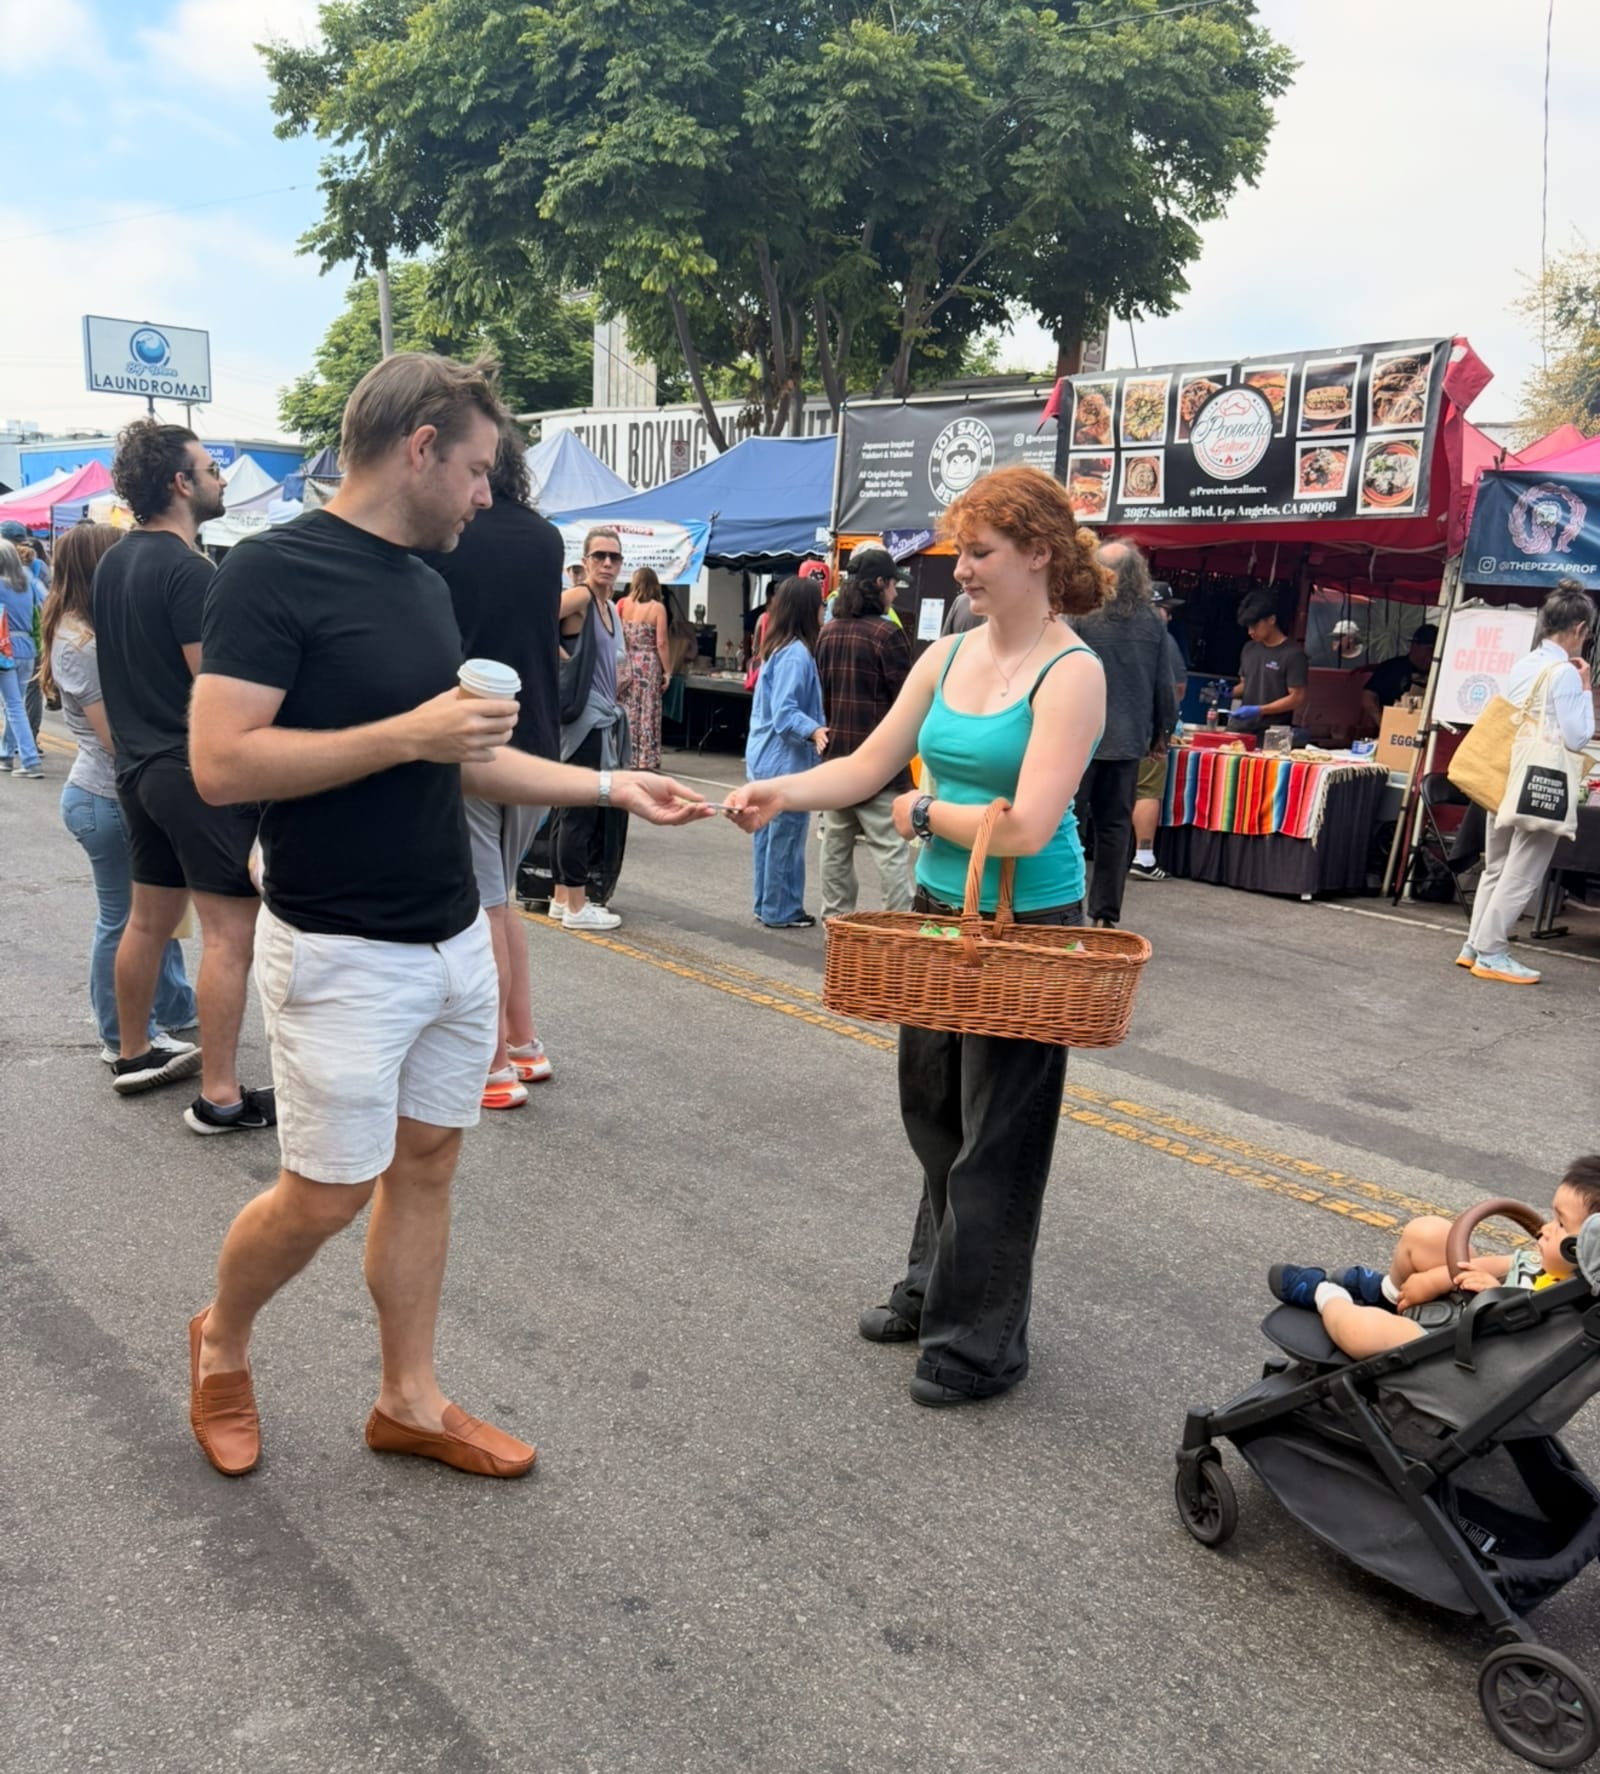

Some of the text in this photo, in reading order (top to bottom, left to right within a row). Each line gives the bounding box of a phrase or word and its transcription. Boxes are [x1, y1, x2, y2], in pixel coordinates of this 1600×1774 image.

[94, 373, 208, 398] LAUNDROMAT
[1191, 415, 1273, 445] Provecho
[933, 420, 992, 460] SOY SAUCE
[1149, 506, 1190, 518] Sawtelle
[1218, 505, 1236, 517] Los
[1282, 503, 1298, 515] CA
[1499, 560, 1598, 574] @THEPIZZAPROF
[1474, 626, 1504, 649] WE
[1531, 774, 1563, 788] EVERYBODY
[1527, 782, 1565, 797] EVERYWHERE
[1531, 791, 1560, 803] WANTS TO
[1530, 799, 1556, 811] BE FREE
